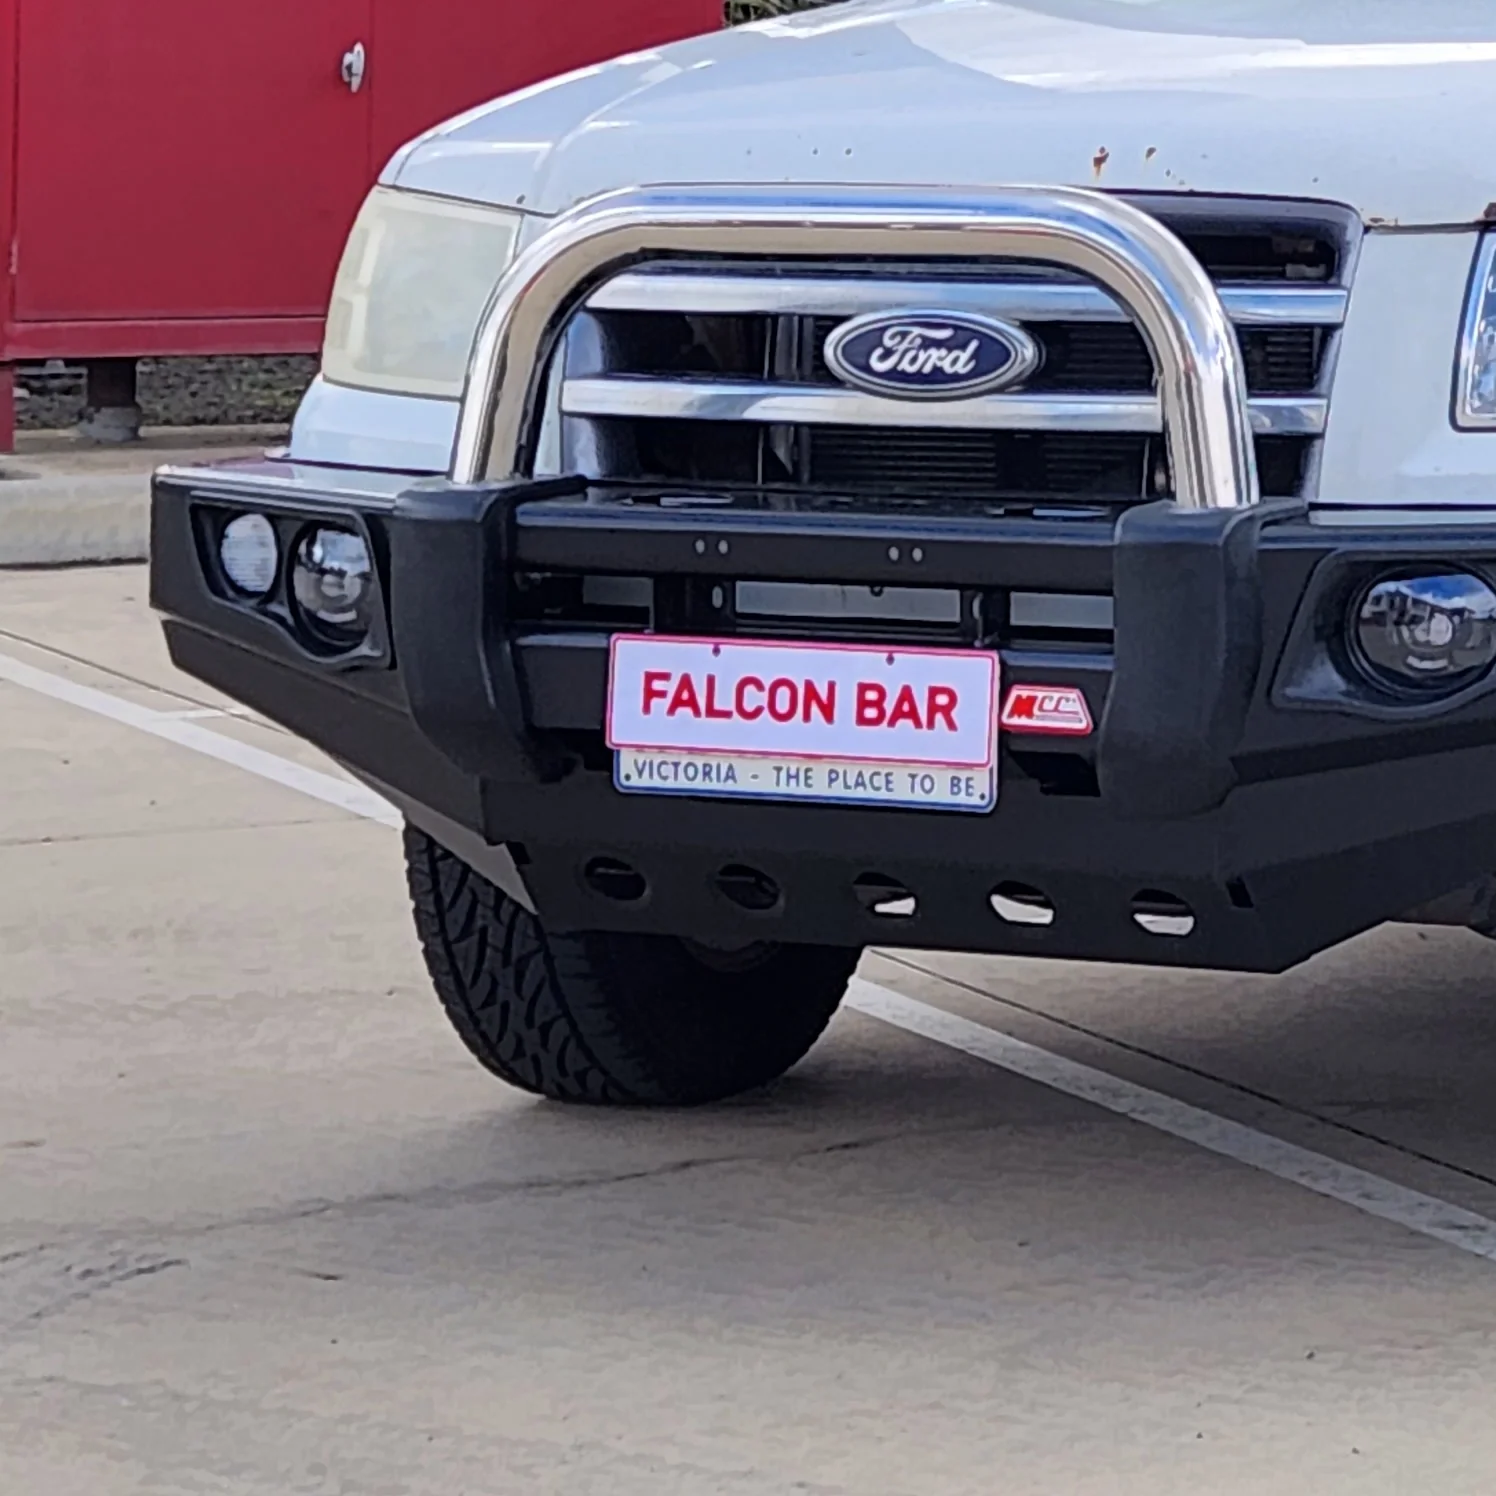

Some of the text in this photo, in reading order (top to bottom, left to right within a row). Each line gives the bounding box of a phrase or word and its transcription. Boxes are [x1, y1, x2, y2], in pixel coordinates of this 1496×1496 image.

[868, 325, 980, 374] Ford
[641, 670, 959, 732] FALCON BAR
[633, 760, 738, 784] VICTORIA
[773, 766, 814, 788] THE
[827, 771, 895, 793] PLACE
[907, 773, 936, 794] TO
[949, 775, 976, 797] BE
